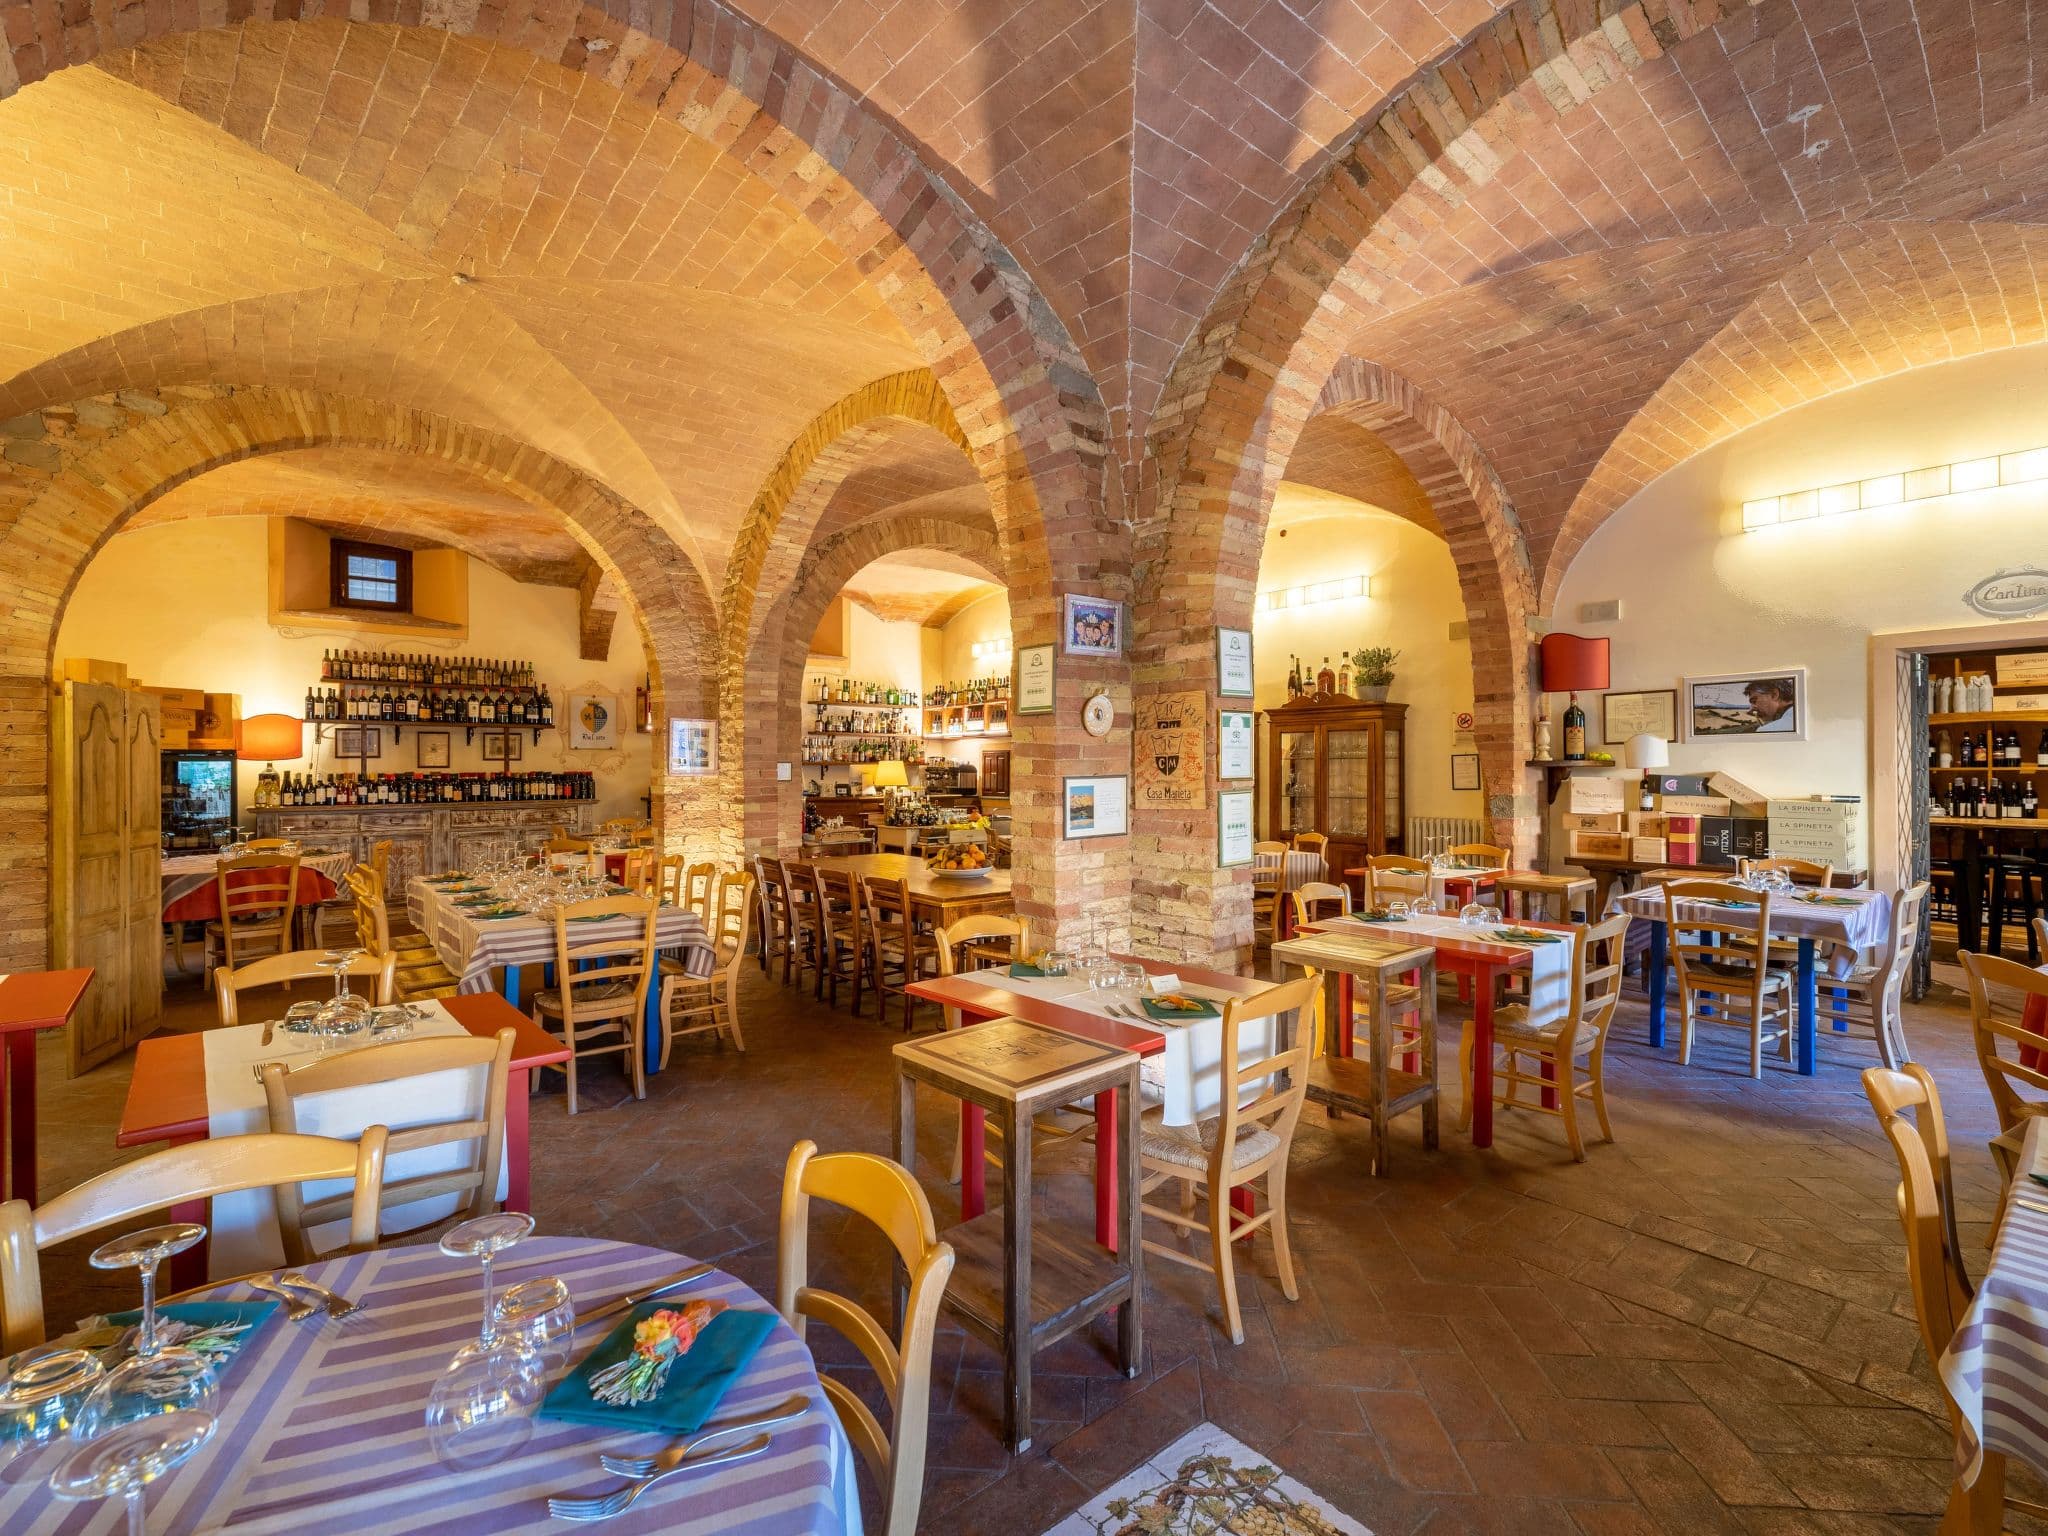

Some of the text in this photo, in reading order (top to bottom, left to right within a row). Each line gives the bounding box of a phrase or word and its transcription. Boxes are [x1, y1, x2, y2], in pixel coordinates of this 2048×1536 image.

[1983, 584, 2047, 601] Cantina
[1146, 787, 1163, 799] Casa
[1721, 829, 1729, 853] BOCELLI
